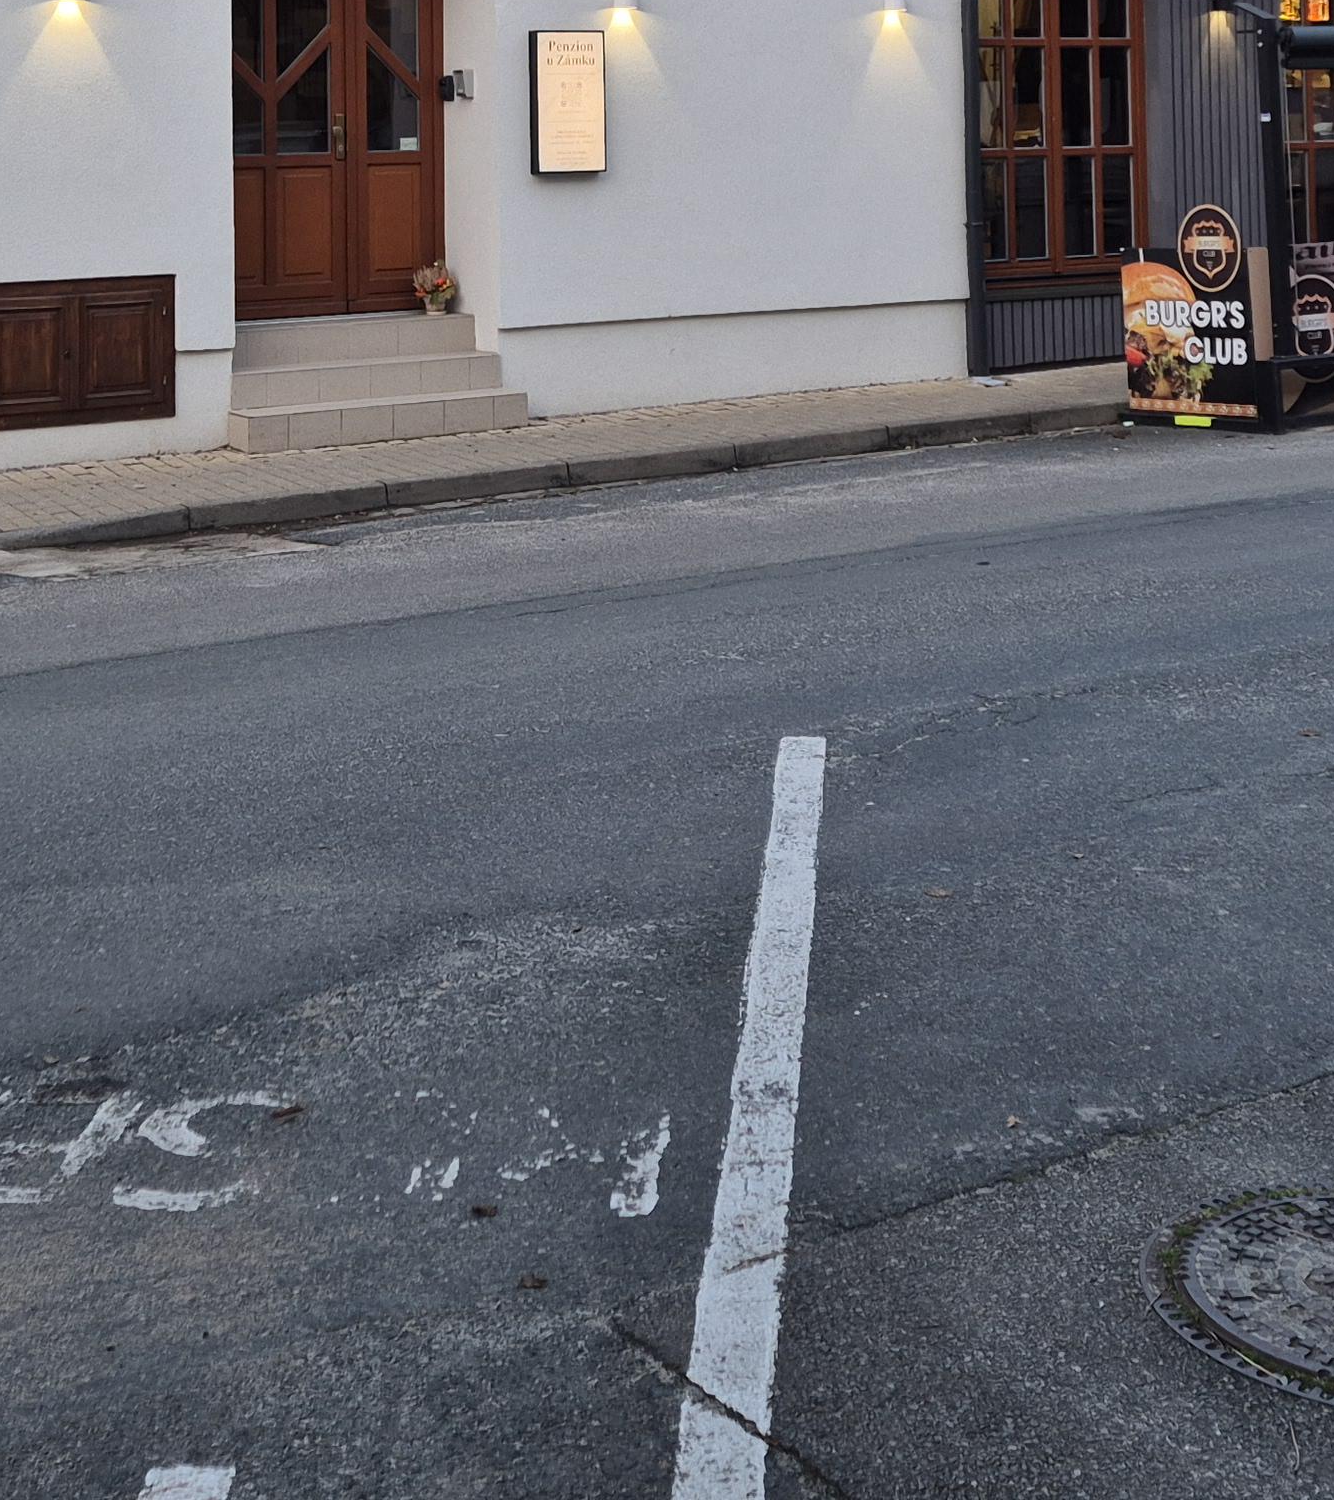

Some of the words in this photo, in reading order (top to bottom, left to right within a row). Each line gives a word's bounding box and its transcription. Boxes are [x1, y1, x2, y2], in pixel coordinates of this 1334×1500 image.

[548, 40, 594, 53] Penzion
[547, 57, 553, 66] u
[556, 54, 596, 66] Zámku
[1145, 299, 1246, 330] BURGR'S
[1184, 336, 1248, 366] CLUB
